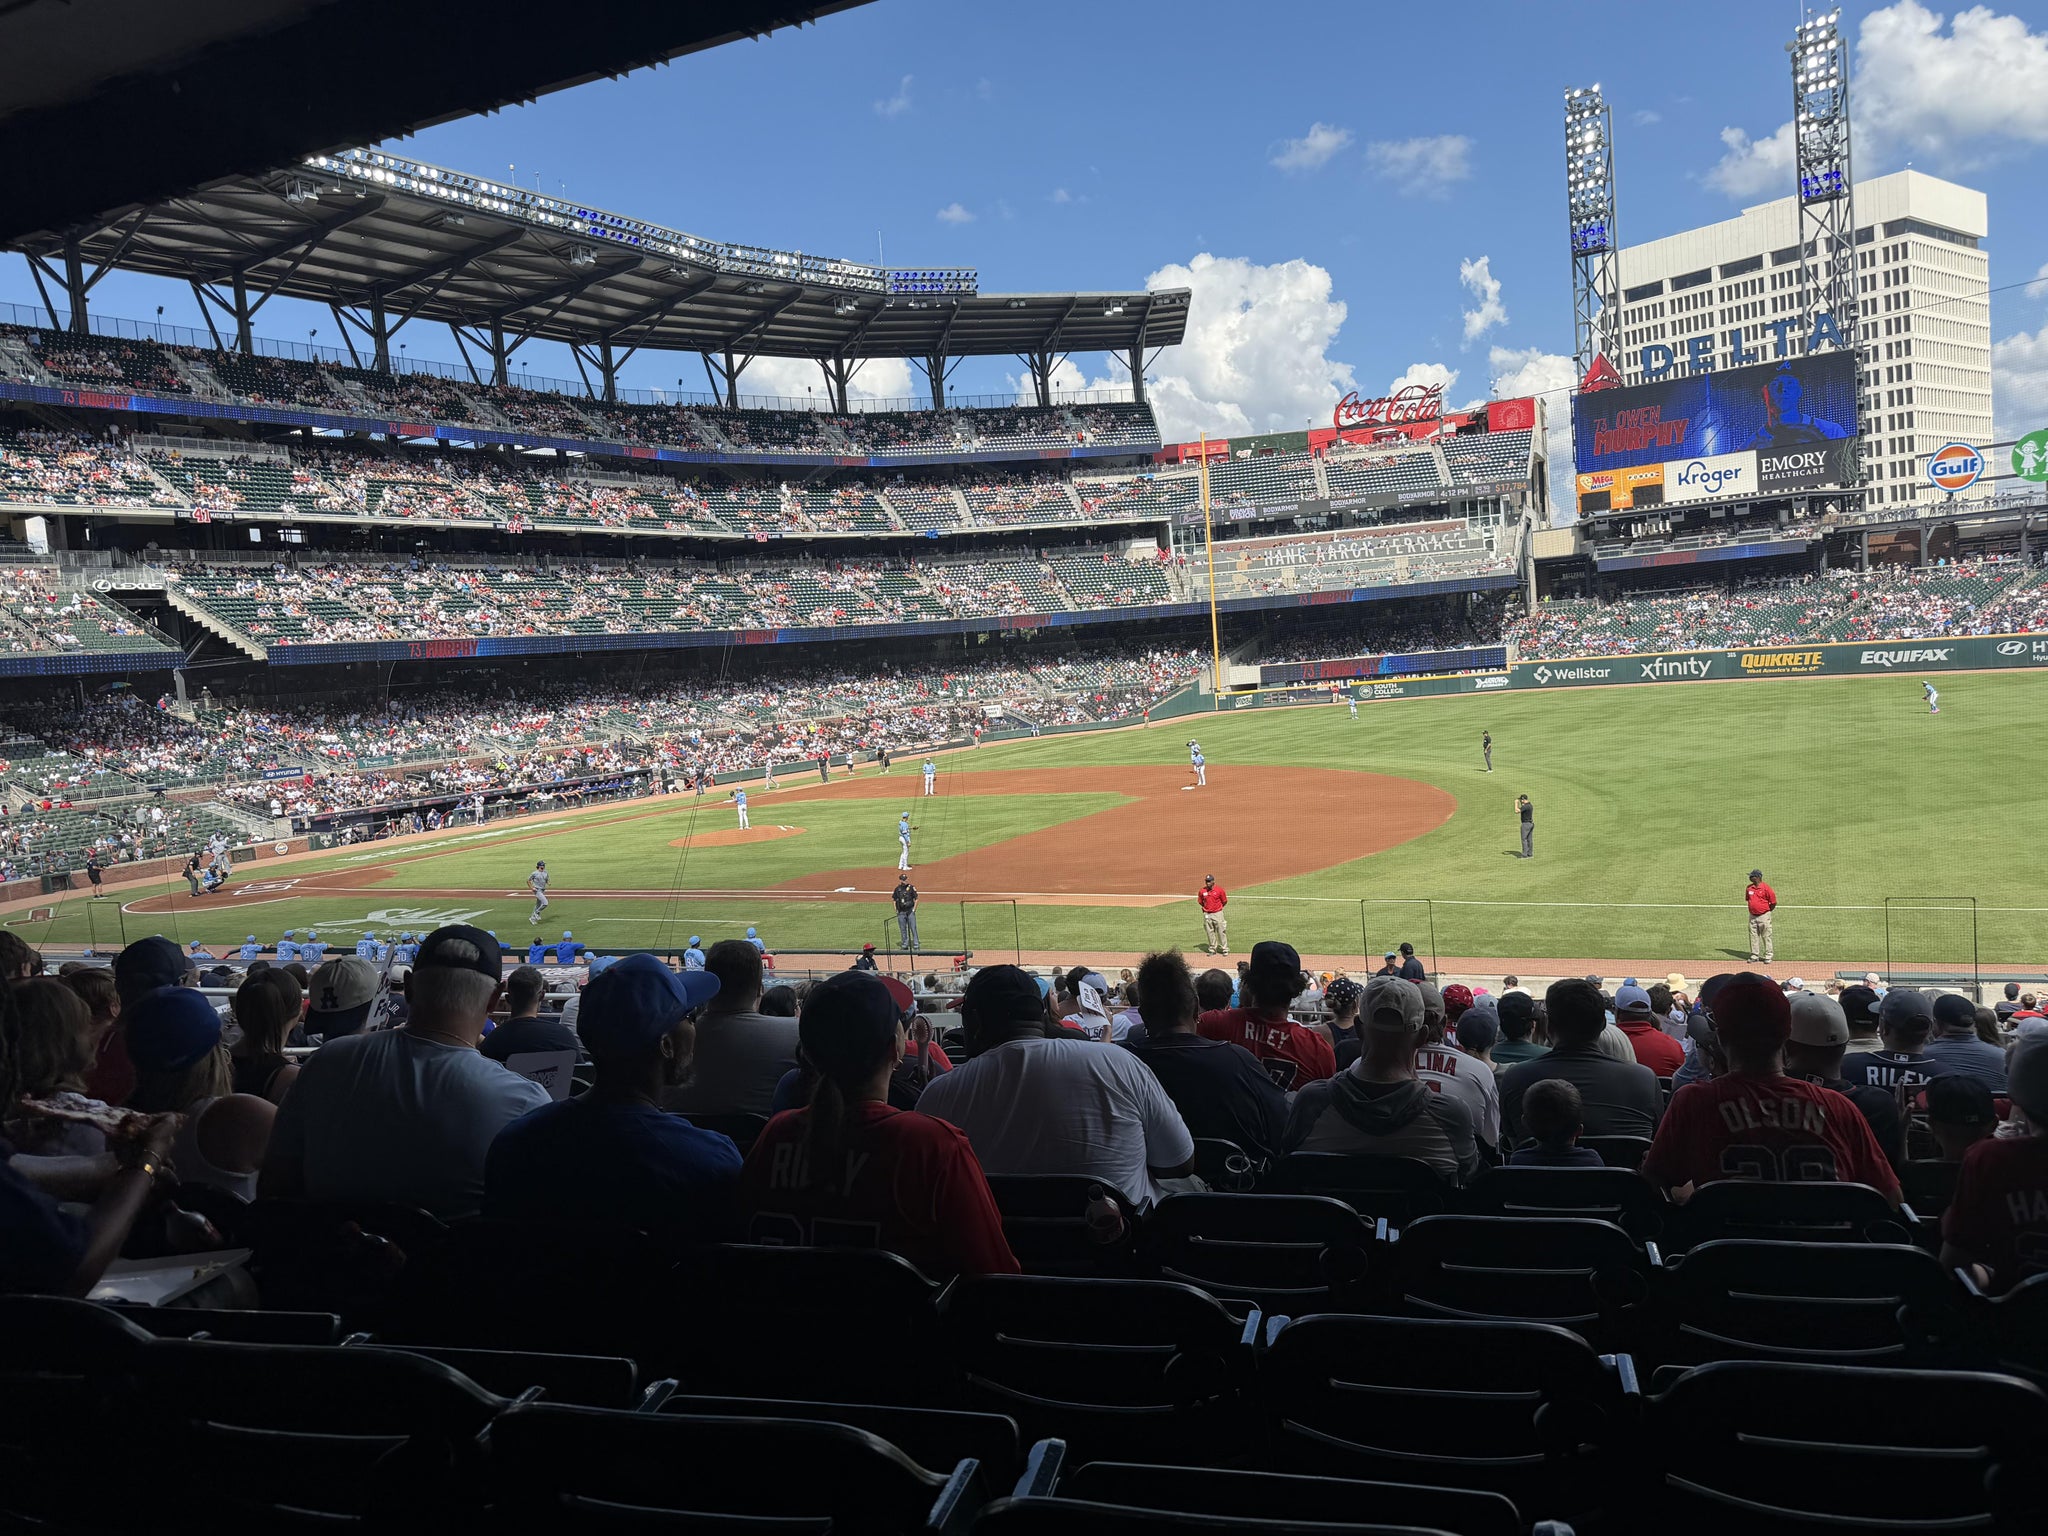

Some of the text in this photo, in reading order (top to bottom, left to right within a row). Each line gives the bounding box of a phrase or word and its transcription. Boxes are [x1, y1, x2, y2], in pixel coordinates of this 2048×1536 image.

[1641, 313, 1845, 378] DELTA
[1334, 383, 1447, 428] Coca-Cola
[1593, 405, 1661, 432] 73 OWEN
[1593, 418, 1689, 455] MURPHY
[1761, 451, 1828, 473] EMORY
[1931, 456, 1978, 477] Gulf
[1592, 475, 1614, 485] MEGA
[1678, 461, 1742, 493] Kroger
[1762, 467, 1825, 481] HEALTHCARE
[1440, 489, 1456, 497] 4:12
[1457, 488, 1469, 496] PM
[193, 507, 211, 523] 41
[507, 520, 523, 534] 44
[1264, 532, 1467, 567] HANK AARON TERRACE
[408, 640, 479, 658] 73 MURPHY
[1860, 648, 1949, 667] EQUIFAX
[1641, 656, 1712, 680] xfinity
[1741, 652, 1823, 669] QUIKRETE
[1554, 667, 1610, 680] Wellstar
[1374, 688, 1404, 696] COLLEGE
[276, 768, 301, 776] HYUNDAI
[321, 987, 339, 1009] A
[1244, 1021, 1290, 1050] RILEY
[1866, 1065, 1932, 1088] RILEY
[1718, 1096, 1826, 1136] OLSON
[769, 1141, 871, 1197] RILY
